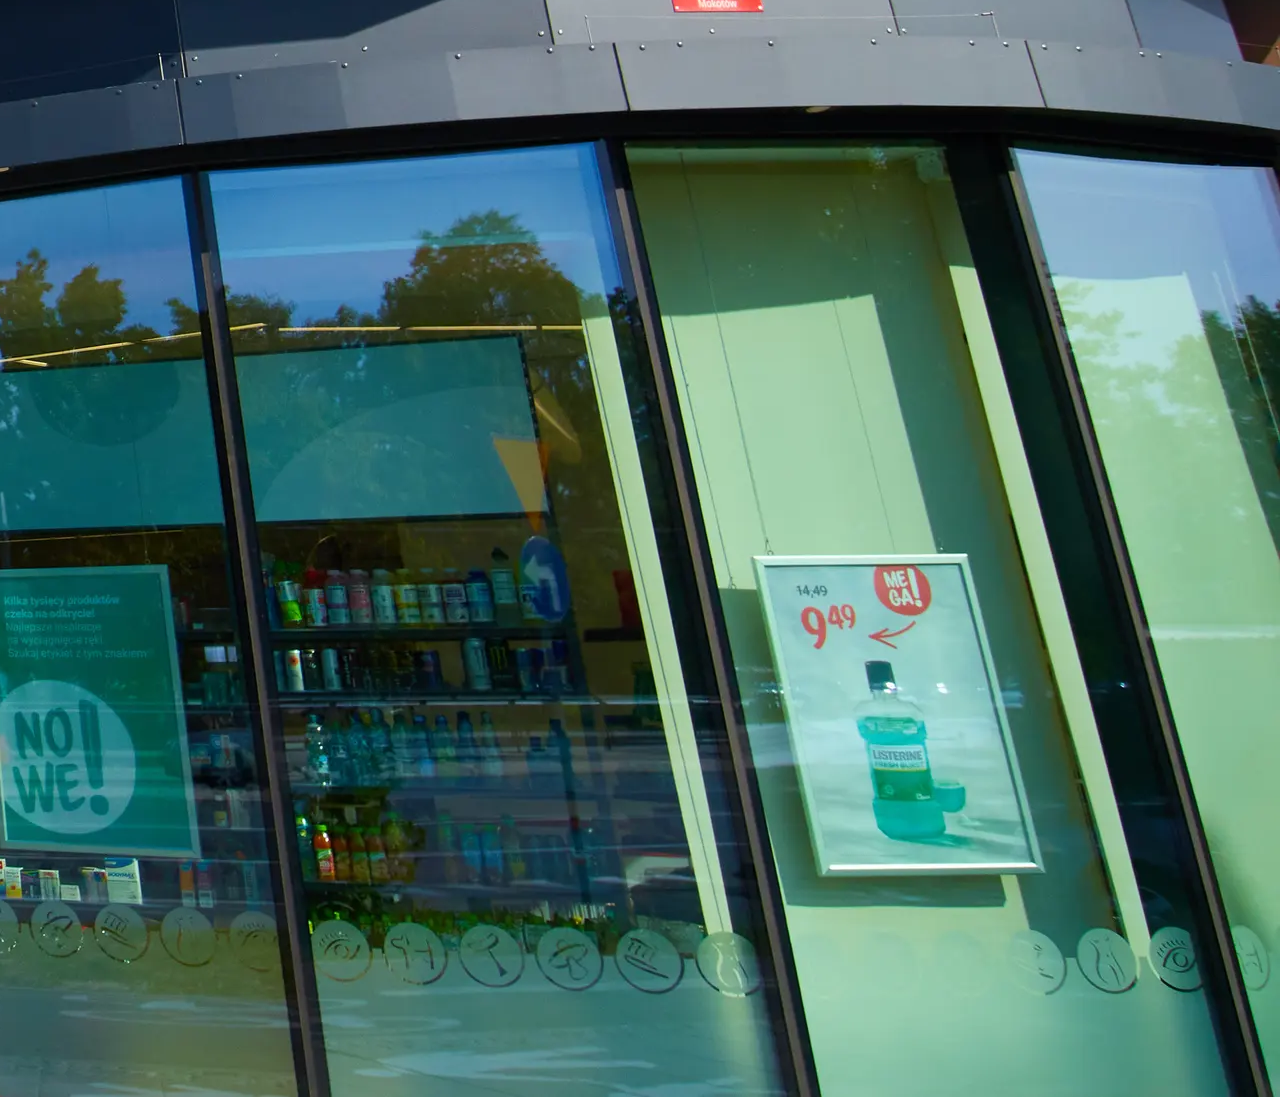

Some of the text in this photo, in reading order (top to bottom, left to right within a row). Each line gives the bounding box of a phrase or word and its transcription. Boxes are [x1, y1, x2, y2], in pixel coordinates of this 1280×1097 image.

[883, 570, 908, 588] ME
[797, 585, 828, 598] 14,49
[4, 594, 120, 607] Kilka tysięcy produktów
[4, 609, 33, 618] czeka
[35, 610, 48, 618] na
[8, 648, 39, 660] Szukaj
[13, 707, 73, 760] NO
[872, 749, 924, 761] LISTERINE
